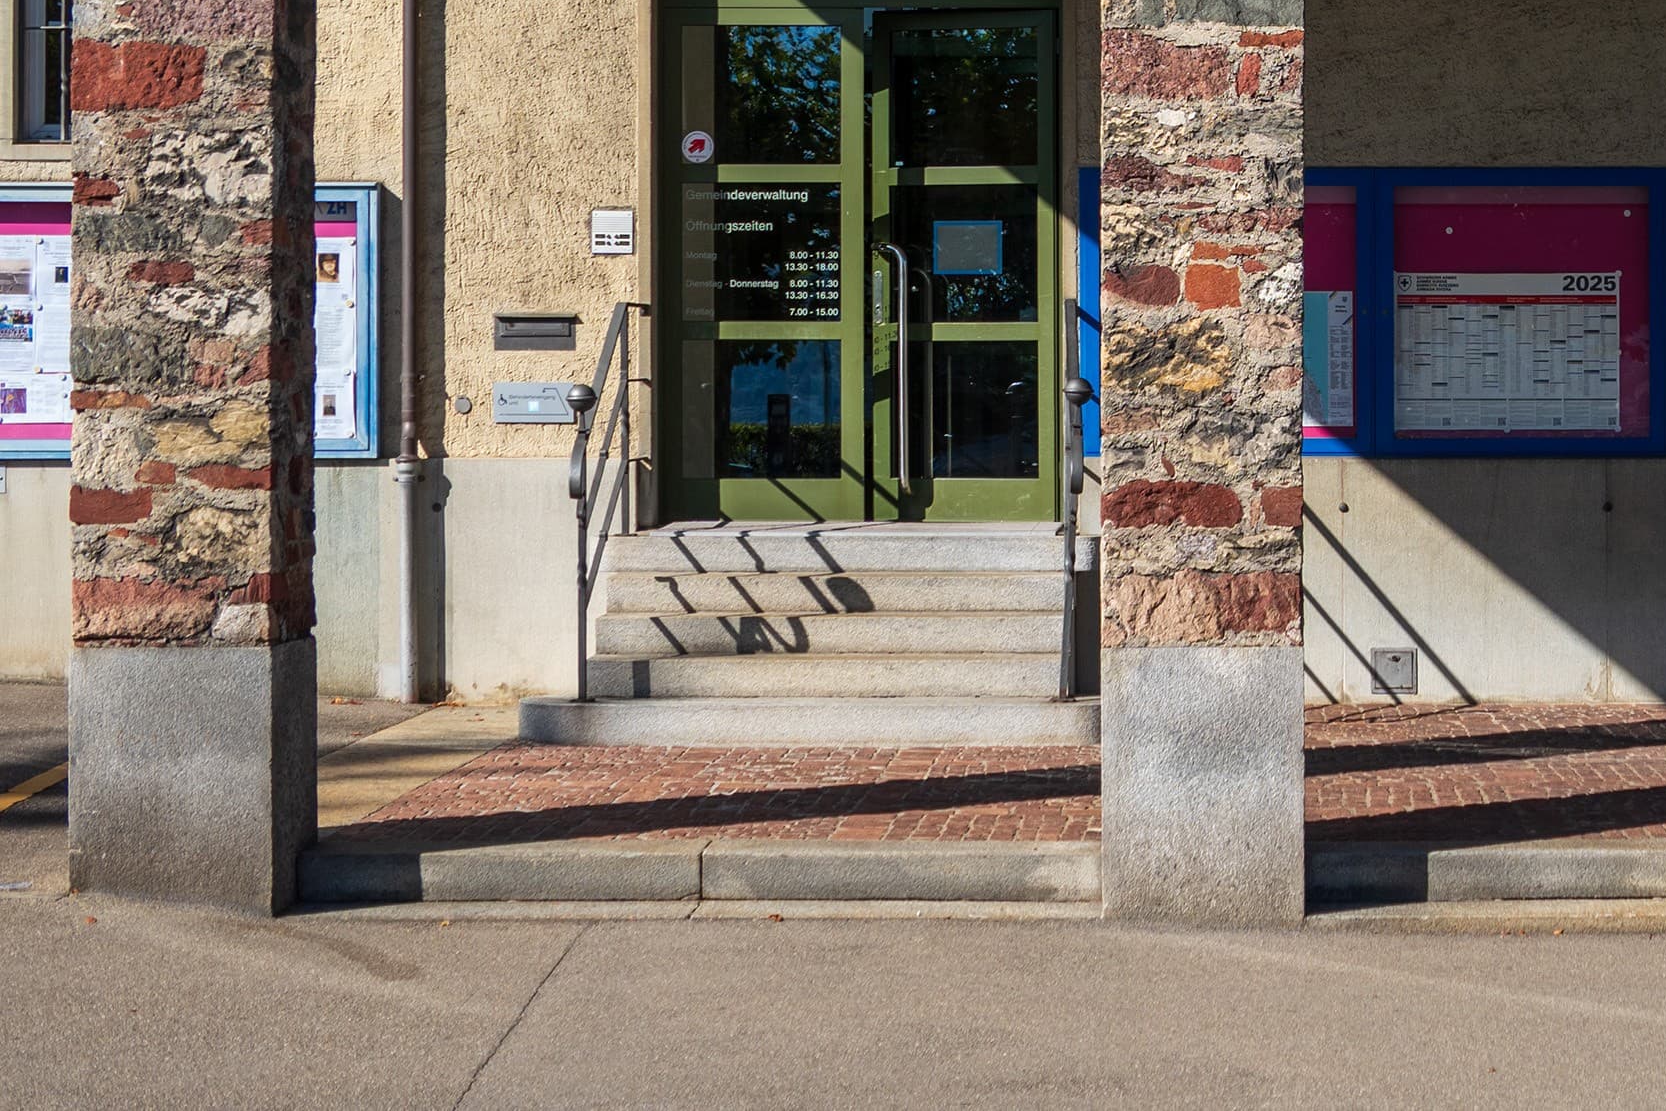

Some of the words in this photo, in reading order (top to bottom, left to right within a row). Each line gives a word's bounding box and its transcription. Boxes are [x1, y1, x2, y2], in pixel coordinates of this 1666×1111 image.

[687, 189, 809, 203] Gemeindeverwaltung
[327, 202, 347, 215] ZH
[686, 251, 718, 262] Montag
[789, 251, 808, 260] 8.00
[815, 251, 839, 260] 11.30
[785, 263, 808, 271] 13.30
[815, 263, 839, 271] 18.00
[729, 279, 780, 290] Donnerstag
[789, 279, 808, 288] 8.00
[815, 279, 839, 288] 11.30
[1562, 275, 1617, 292] 2025
[785, 291, 808, 300] 13.30
[815, 291, 839, 300] 16.30
[789, 308, 808, 316] 7.00
[815, 308, 839, 316] 15.00
